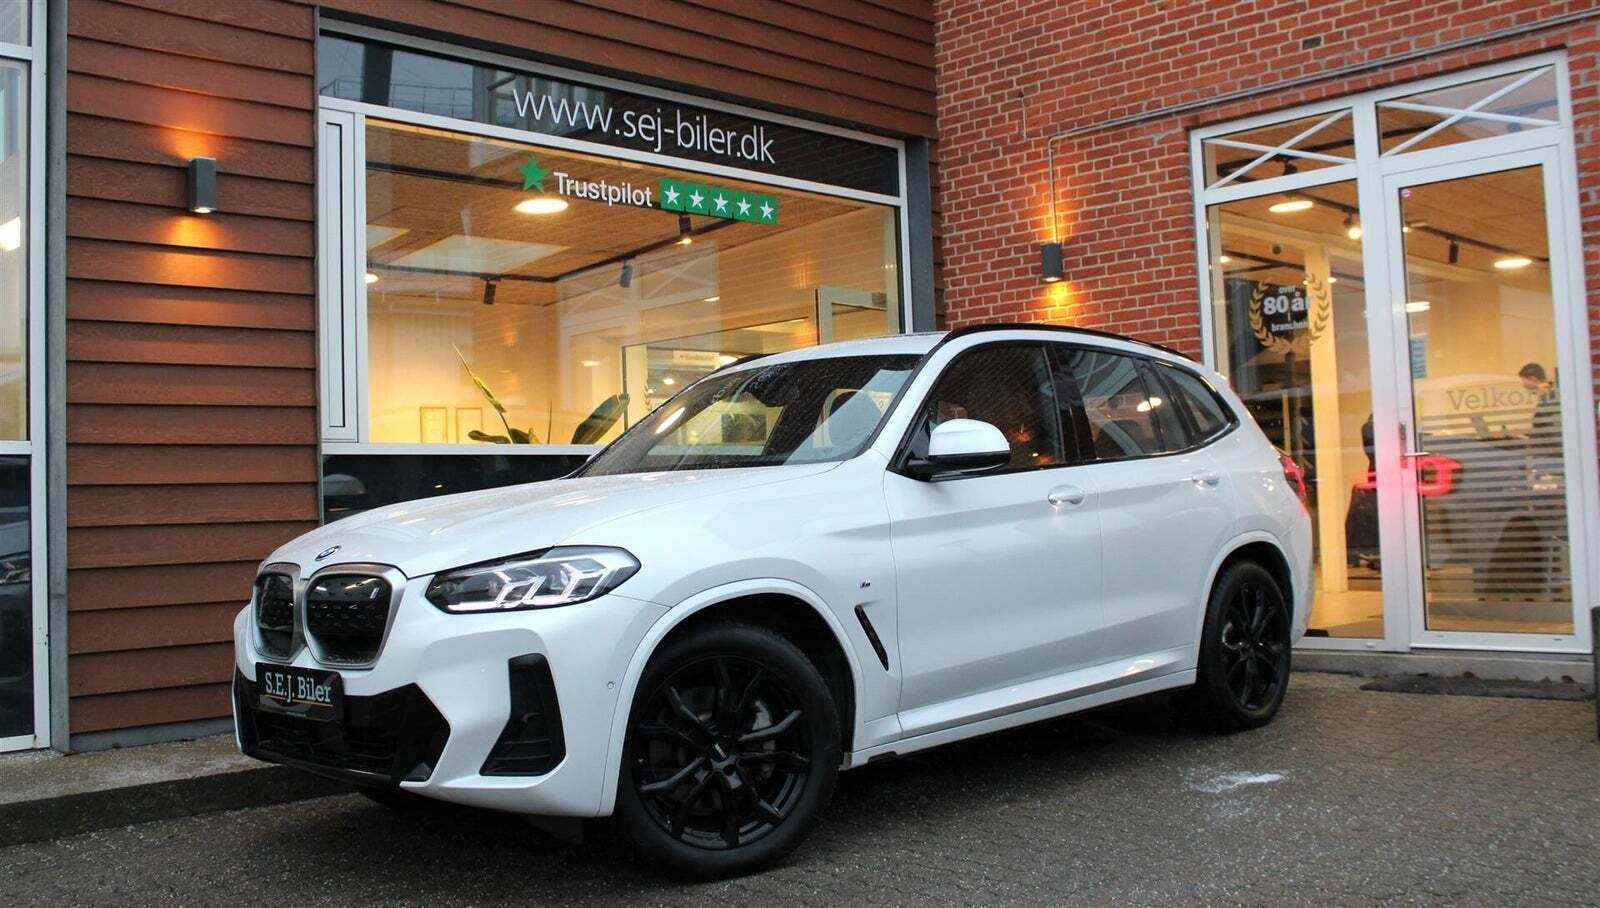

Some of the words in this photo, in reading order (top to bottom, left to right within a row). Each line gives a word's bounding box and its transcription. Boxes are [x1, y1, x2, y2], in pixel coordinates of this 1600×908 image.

[512, 88, 776, 164] www.sej-biler.dk
[553, 171, 653, 207] Trustpilot
[1263, 295, 1289, 315] 80
[265, 671, 295, 703] S.E.J.
[297, 676, 332, 702] Biler
